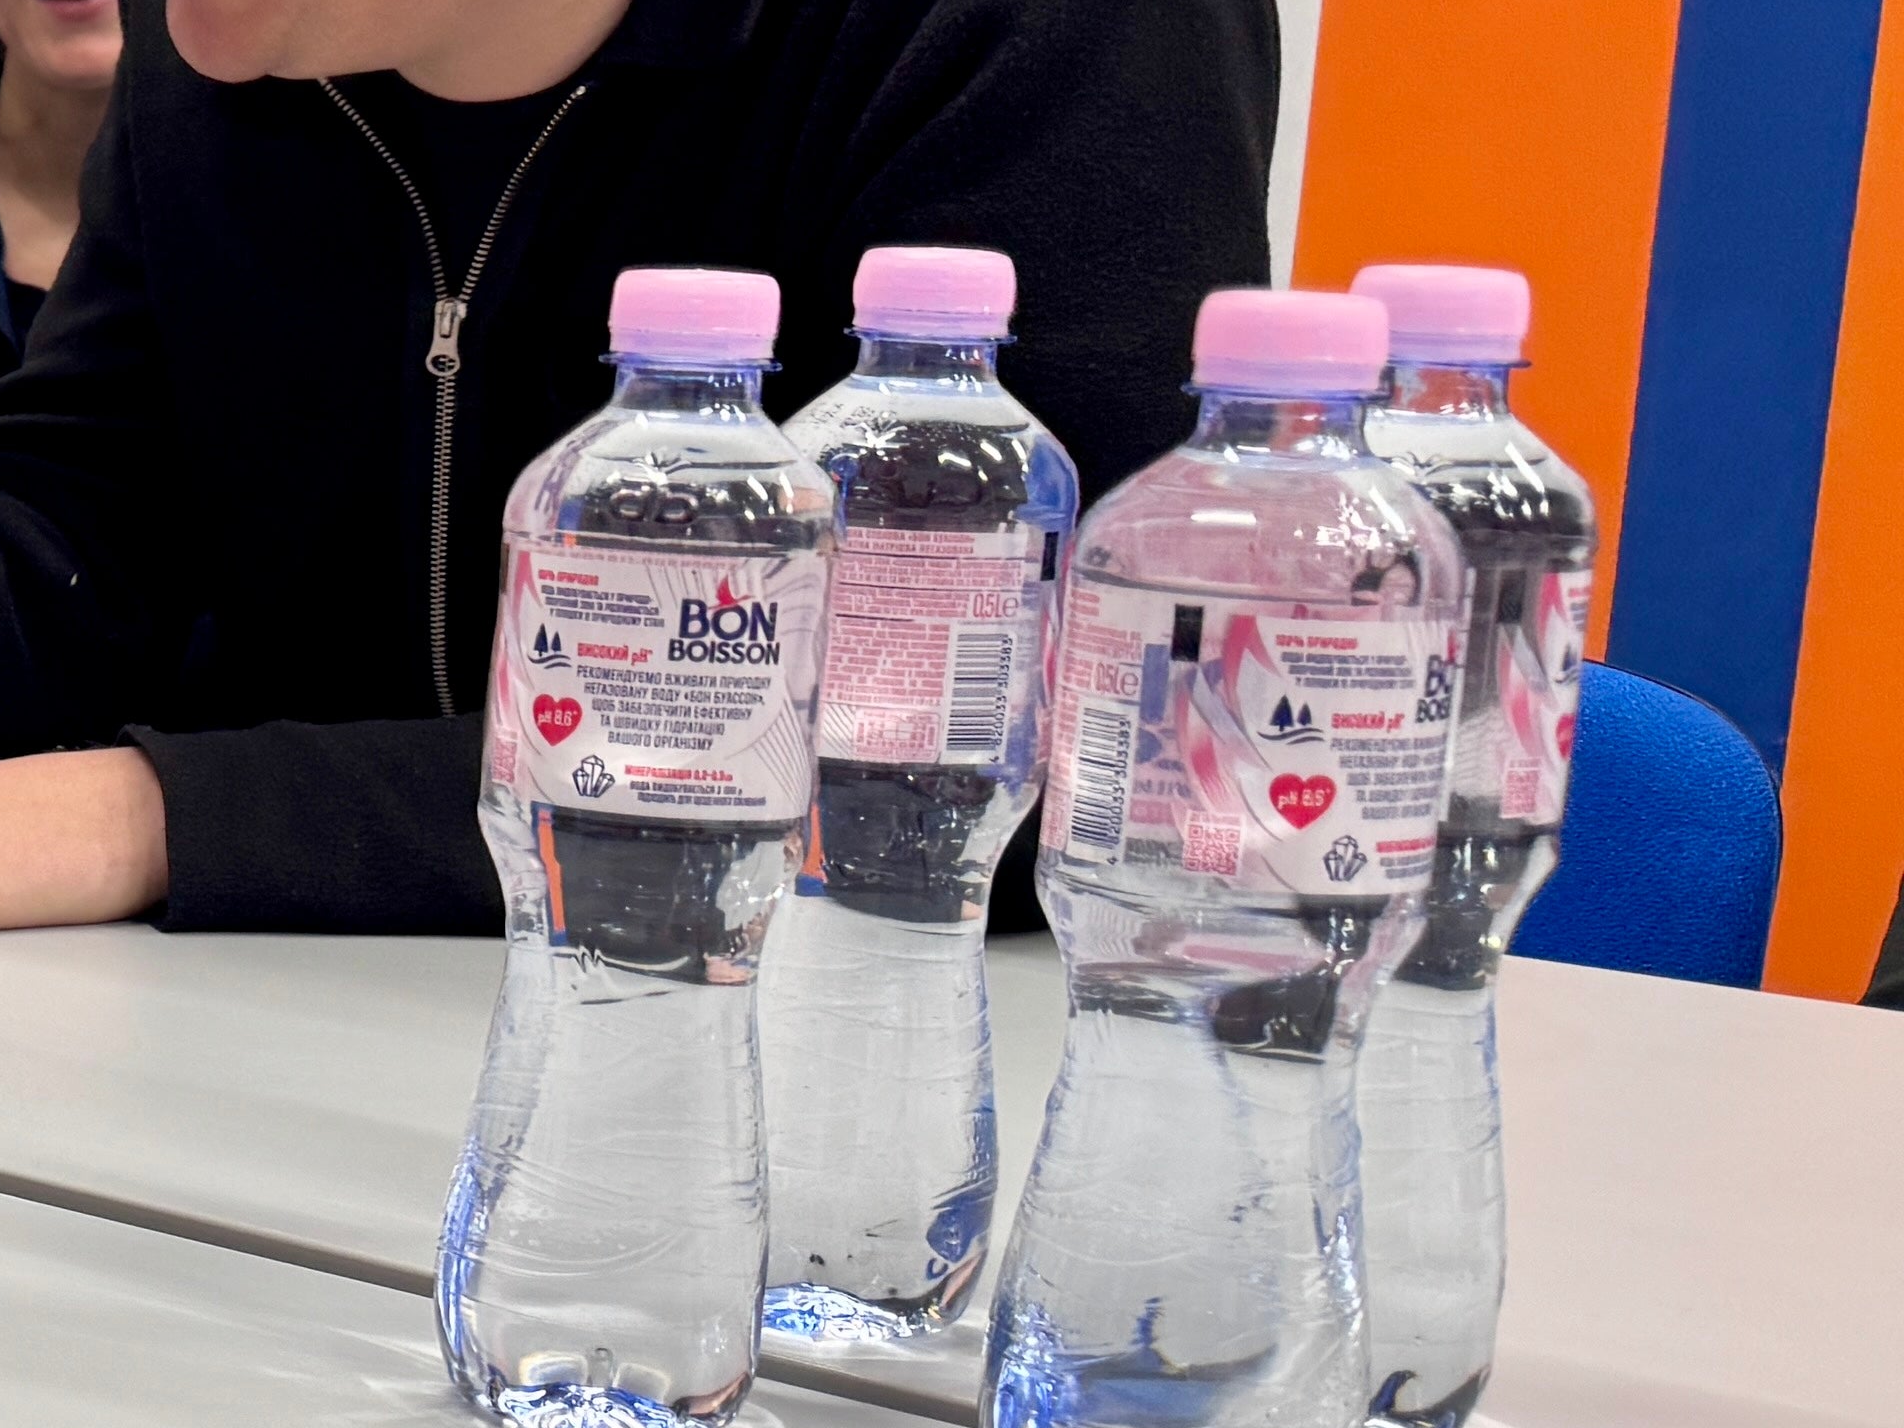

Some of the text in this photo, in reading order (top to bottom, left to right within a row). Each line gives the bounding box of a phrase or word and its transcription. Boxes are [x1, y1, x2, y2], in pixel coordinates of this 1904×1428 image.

[679, 598, 778, 642] BON
[668, 638, 781, 666] BOISSON
[651, 688, 680, 703] ВОДУ
